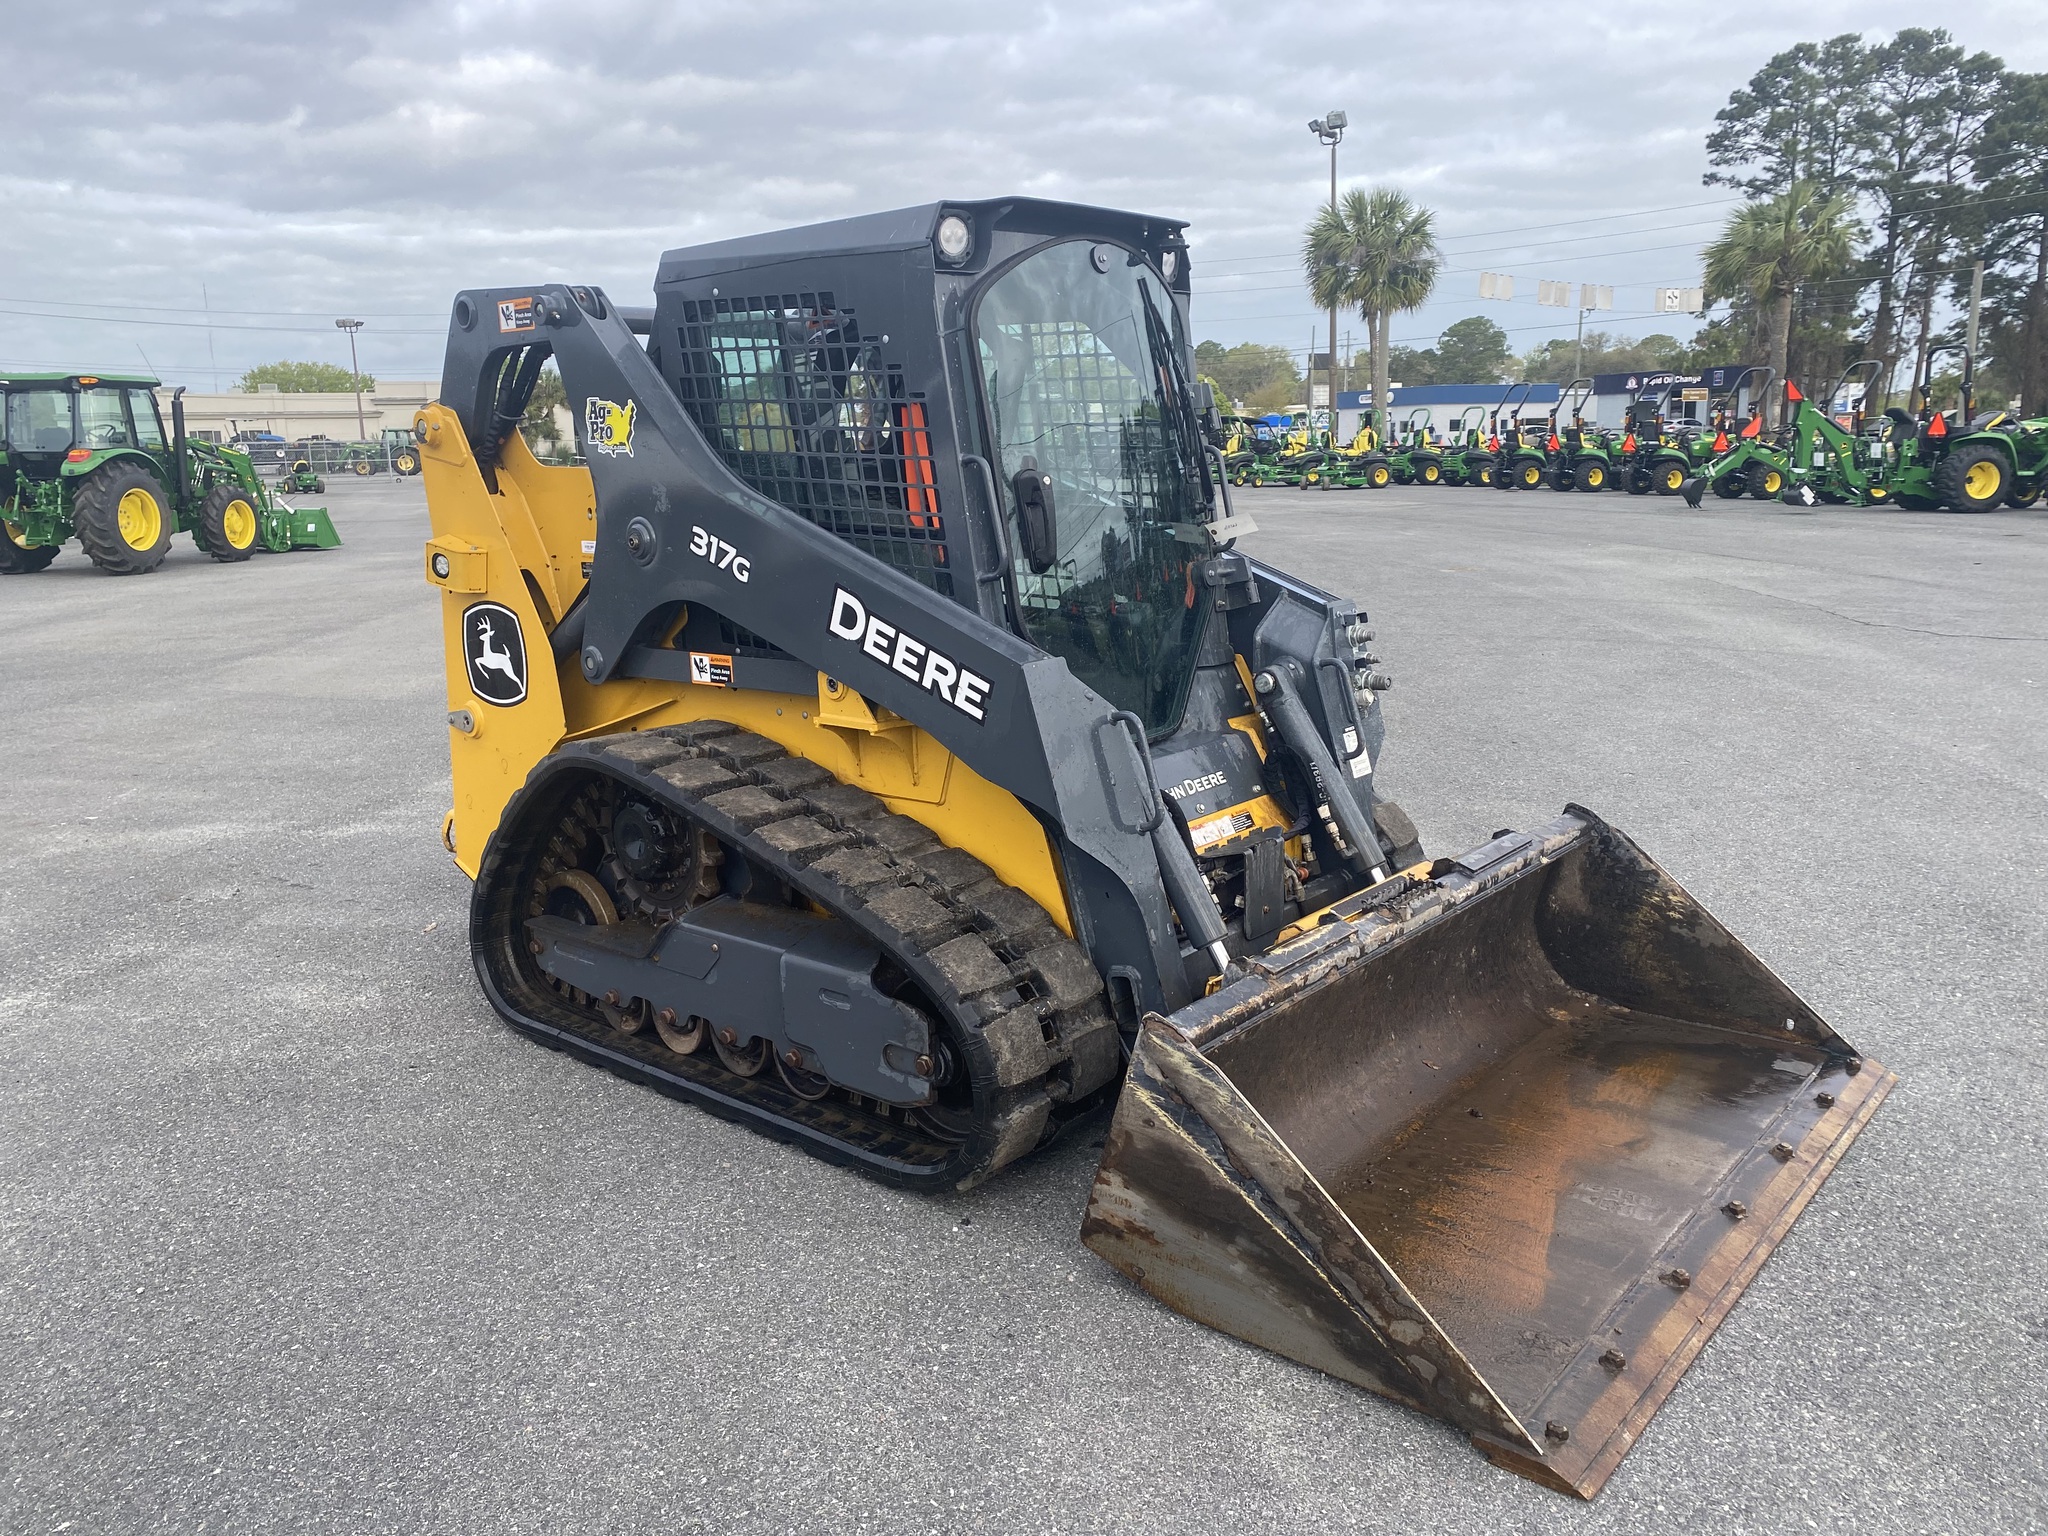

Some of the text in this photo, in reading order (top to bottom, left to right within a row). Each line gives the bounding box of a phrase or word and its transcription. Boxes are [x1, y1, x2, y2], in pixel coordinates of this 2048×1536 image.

[1675, 376, 1702, 384] Change
[589, 400, 611, 424] Ag-
[590, 421, 612, 440] Pro
[690, 525, 750, 582] 317G
[830, 588, 990, 720] DEERE
[1165, 771, 1227, 800] HN DEERE
